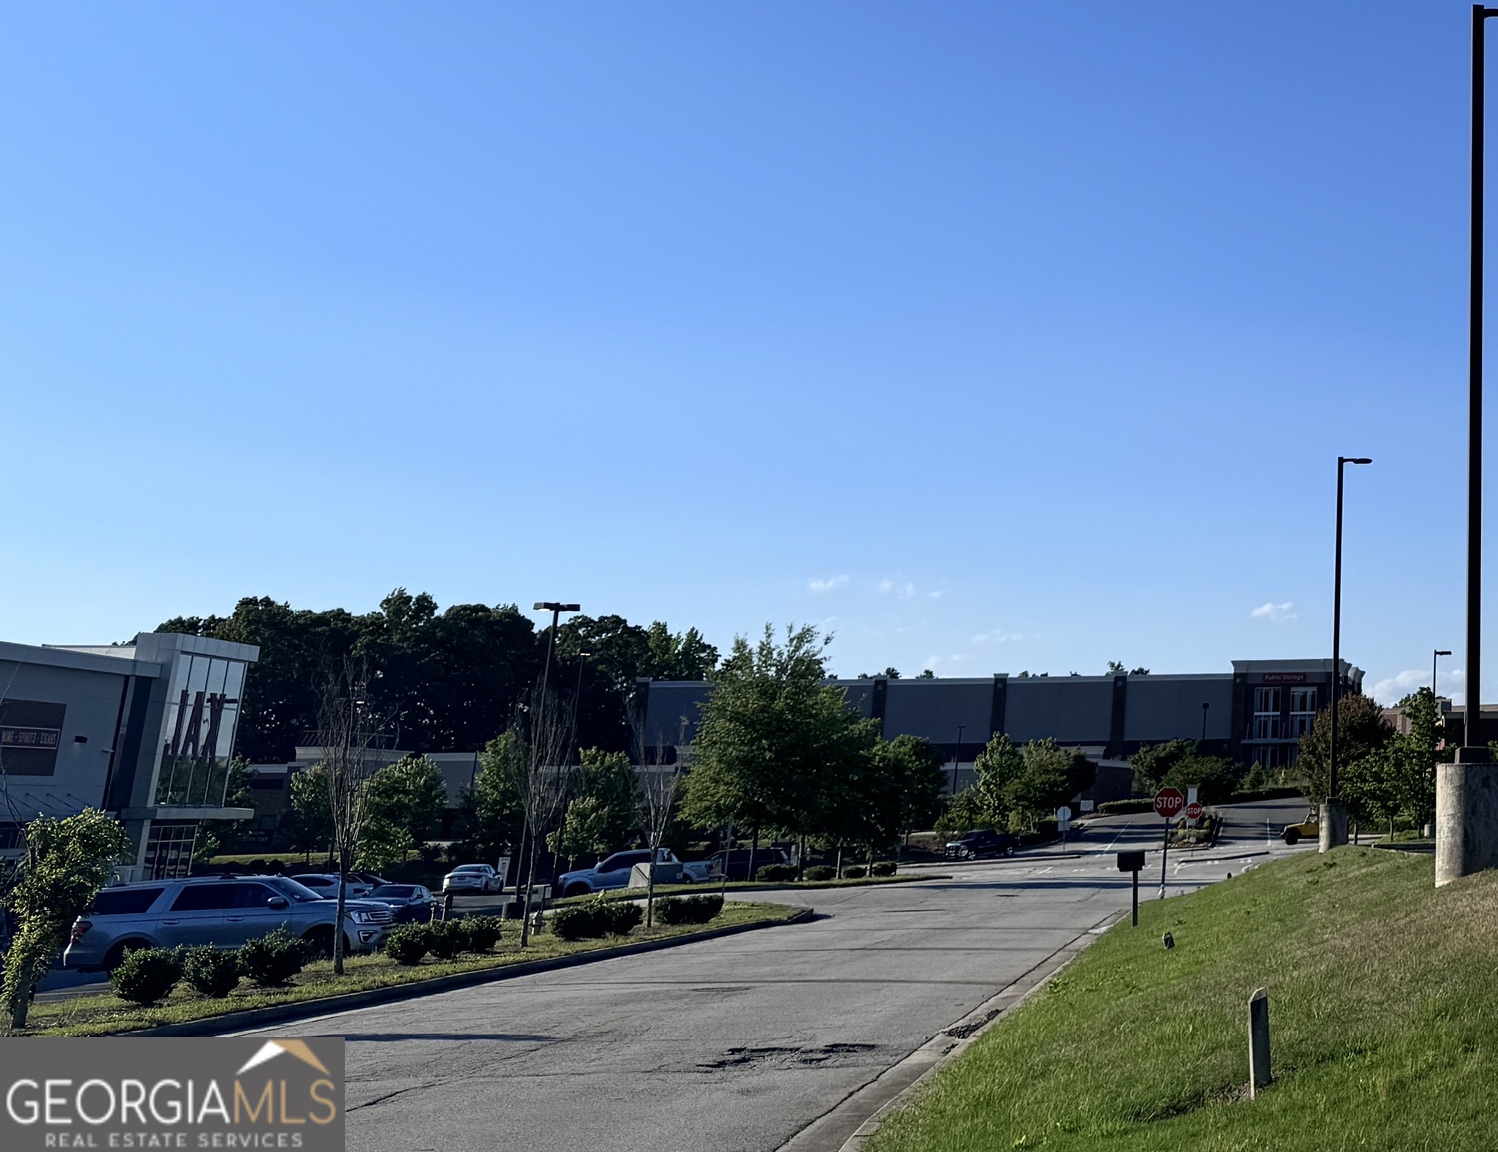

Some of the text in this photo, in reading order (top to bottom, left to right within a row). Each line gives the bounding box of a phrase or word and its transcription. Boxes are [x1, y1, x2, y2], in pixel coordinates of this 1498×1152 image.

[162, 690, 227, 761] JAX
[1156, 796, 1182, 809] STOP
[1187, 807, 1201, 815] STOP
